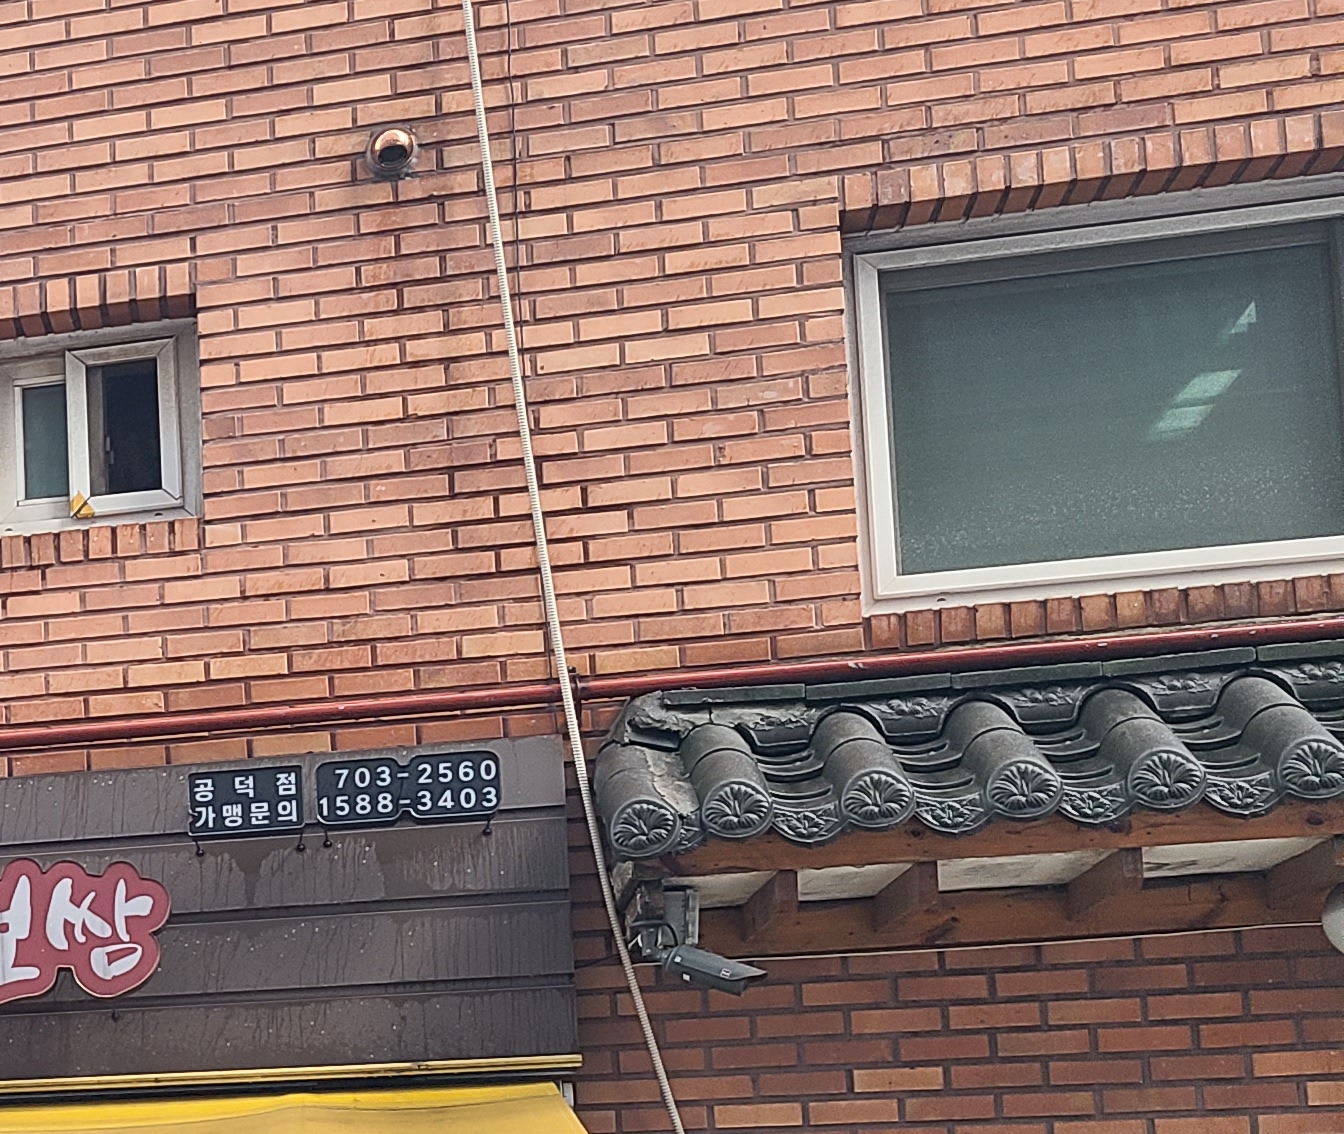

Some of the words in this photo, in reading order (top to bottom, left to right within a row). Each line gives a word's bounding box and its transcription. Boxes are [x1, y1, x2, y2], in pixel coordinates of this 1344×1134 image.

[333, 758, 499, 790] 703-2560
[193, 799, 299, 829] 가맹문의
[318, 785, 499, 818] 1588-3403
